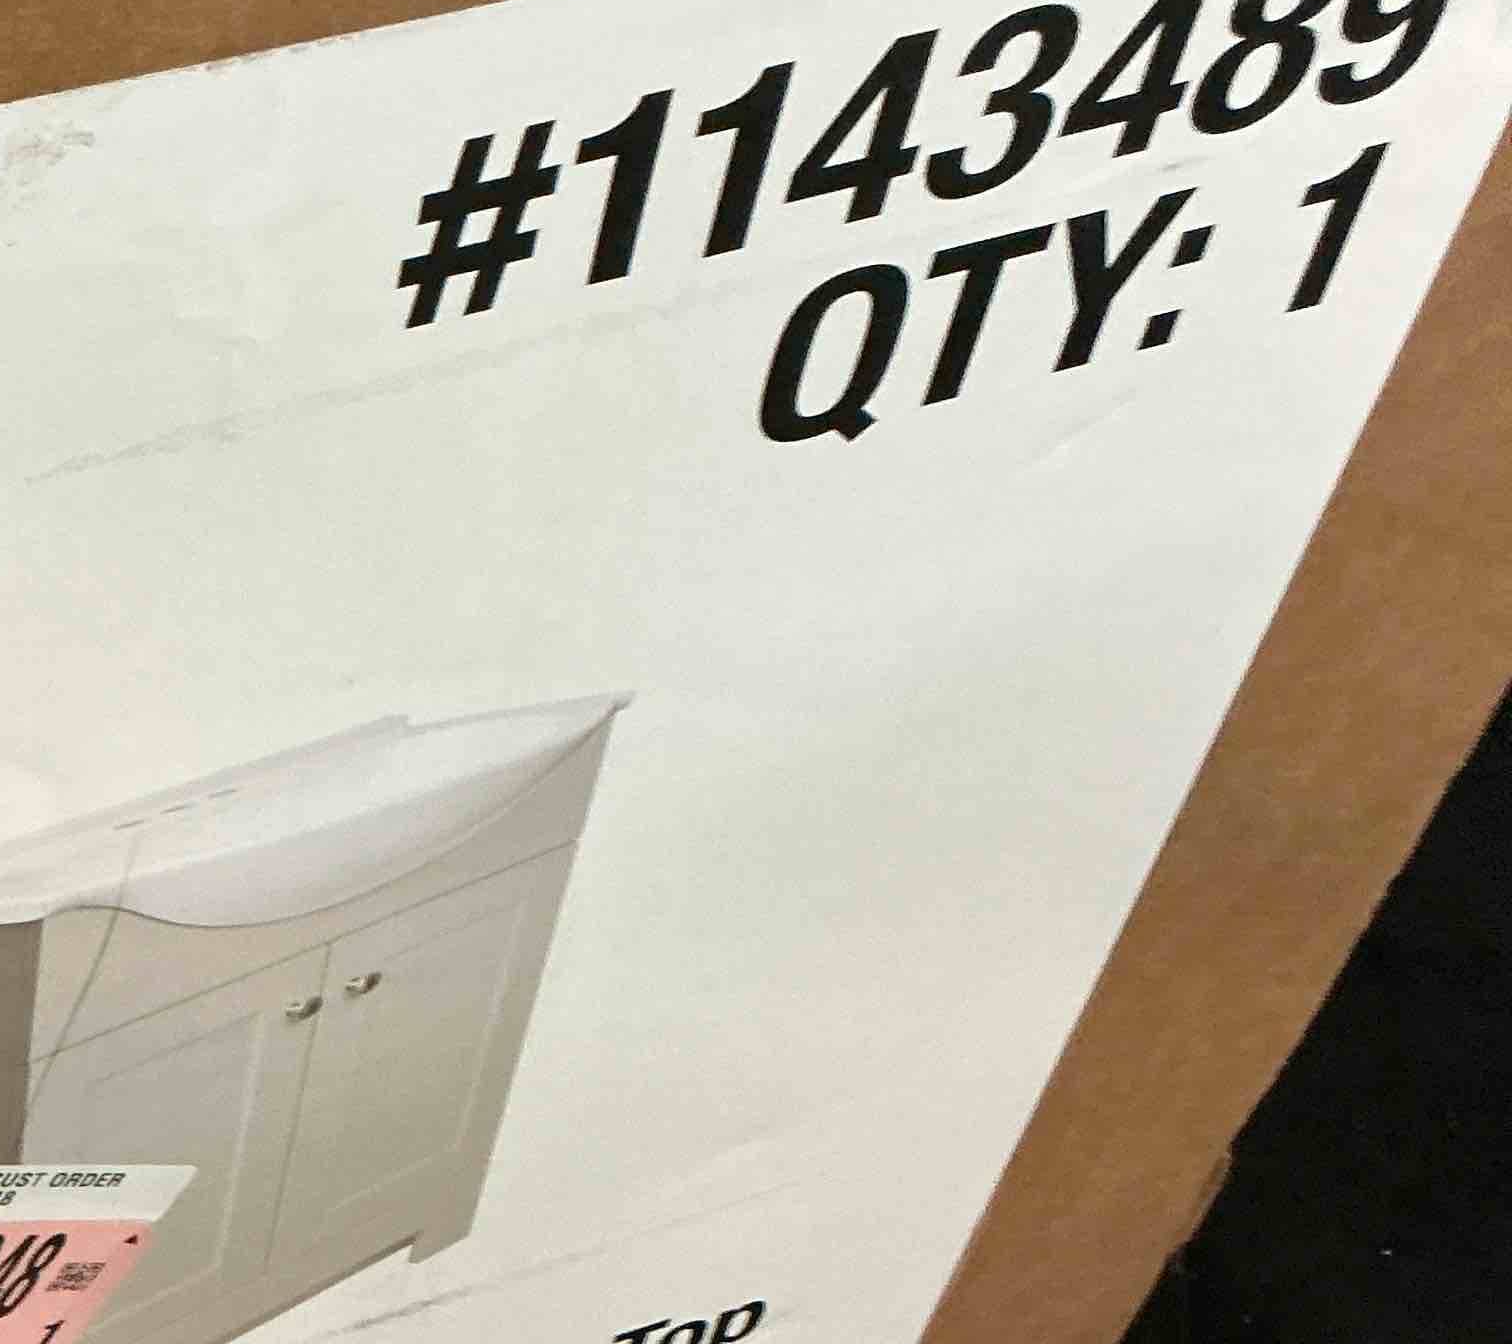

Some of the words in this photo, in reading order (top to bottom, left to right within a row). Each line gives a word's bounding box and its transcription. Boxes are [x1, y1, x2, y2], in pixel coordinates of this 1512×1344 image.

[758, 189, 1216, 441] QTY:
[1286, 142, 1389, 312] 1
[49, 1172, 127, 1188] ORDER
